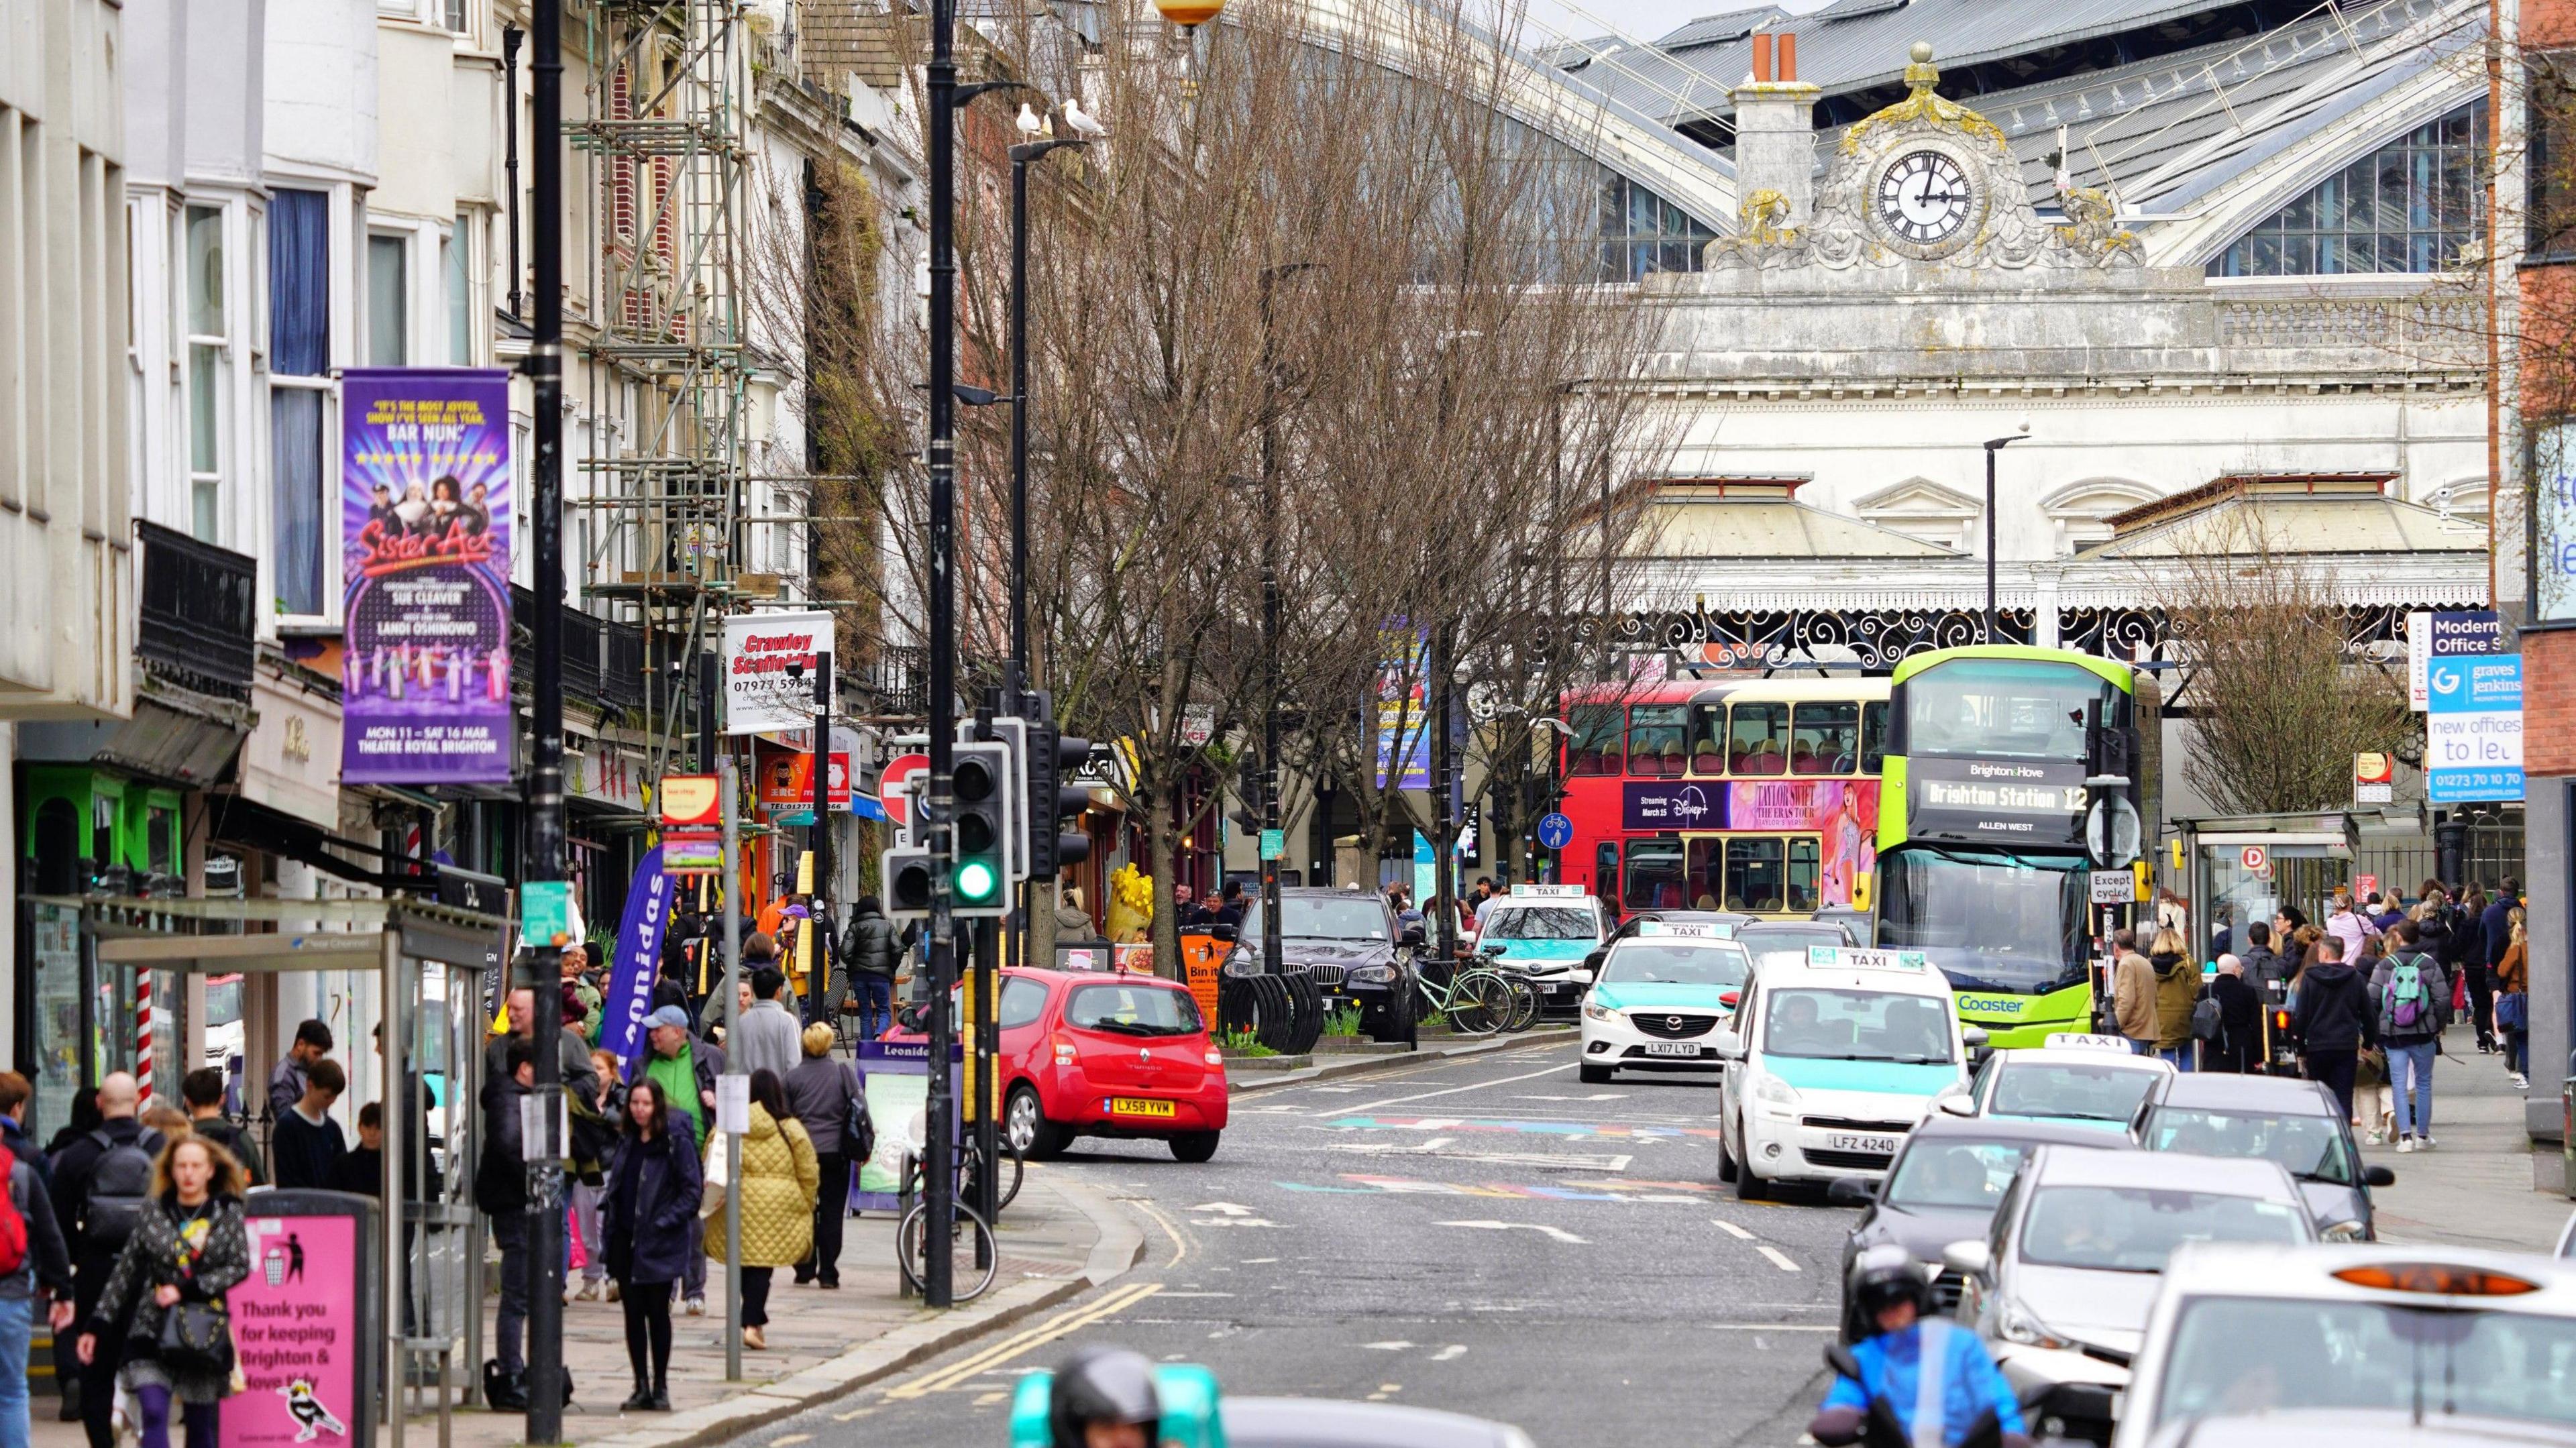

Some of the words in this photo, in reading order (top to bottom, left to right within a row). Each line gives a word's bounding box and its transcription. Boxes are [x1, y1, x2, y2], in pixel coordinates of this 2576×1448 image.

[387, 424, 419, 441] BAR
[359, 518, 441, 565] Sister
[437, 517, 499, 562] Act
[392, 592, 414, 605] SUE
[415, 591, 463, 605] CLEAVER
[377, 621, 411, 636] LANDI
[413, 621, 478, 636] OSHINOWO
[2435, 620, 2500, 634] Modern
[745, 632, 813, 653] Crawley
[2435, 638, 2487, 653] Office
[733, 653, 818, 674] Scaffolin
[2473, 665, 2515, 679] graves
[734, 679, 774, 691] 07977
[2472, 679, 2522, 695] jenkins
[366, 726, 396, 739] MON
[398, 726, 412, 738] 11
[424, 726, 444, 738] SAT
[447, 726, 460, 738] 16
[462, 726, 489, 738] MAR
[2432, 721, 2465, 734] new
[2469, 717, 2522, 734] offices
[358, 739, 402, 754] THEATRE
[405, 739, 439, 754] ROYAL
[441, 739, 497, 754] BRIGHTON
[2445, 739, 2469, 761] to
[2436, 775, 2471, 787] 01273
[2473, 774, 2488, 786] 70
[2490, 773, 2503, 785] 10
[2505, 773, 2521, 785] 70
[1641, 796, 1667, 806] Streaming
[1757, 785, 1788, 806] TAYLOR
[1790, 785, 1815, 806] SWIFT
[1929, 783, 1996, 805] Brighton
[1999, 786, 2056, 808] Station
[2063, 787, 2088, 811] 12
[1642, 807, 1660, 817] March
[1660, 807, 1667, 816] 15
[1756, 807, 1772, 818] THE
[1774, 807, 1793, 818] ERAS
[1794, 807, 1815, 818] TOUR
[1978, 822, 2007, 830] ALLEN
[2008, 822, 2034, 831] WEST
[2094, 875, 2131, 887] Except
[1672, 928, 1701, 936] TAXI
[1850, 954, 1886, 966] TAXI
[1190, 966, 1208, 977] Bin
[1210, 966, 1219, 977] it
[1958, 995, 2024, 1013] Coaster
[2056, 1034, 2121, 1047] TAXI
[1651, 1043, 1672, 1054] LX17
[1674, 1044, 1695, 1054] LYD
[1118, 1100, 1146, 1111] LX58
[1149, 1102, 1169, 1113] YVM
[1833, 1136, 1858, 1150] LFZ
[1862, 1138, 1894, 1152] 4240
[241, 1301, 291, 1317] Thank
[296, 1304, 326, 1321] you
[240, 1325, 264, 1341] for
[268, 1324, 335, 1344] keeping
[241, 1349, 313, 1369] Brighton
[317, 1349, 329, 1365] &
